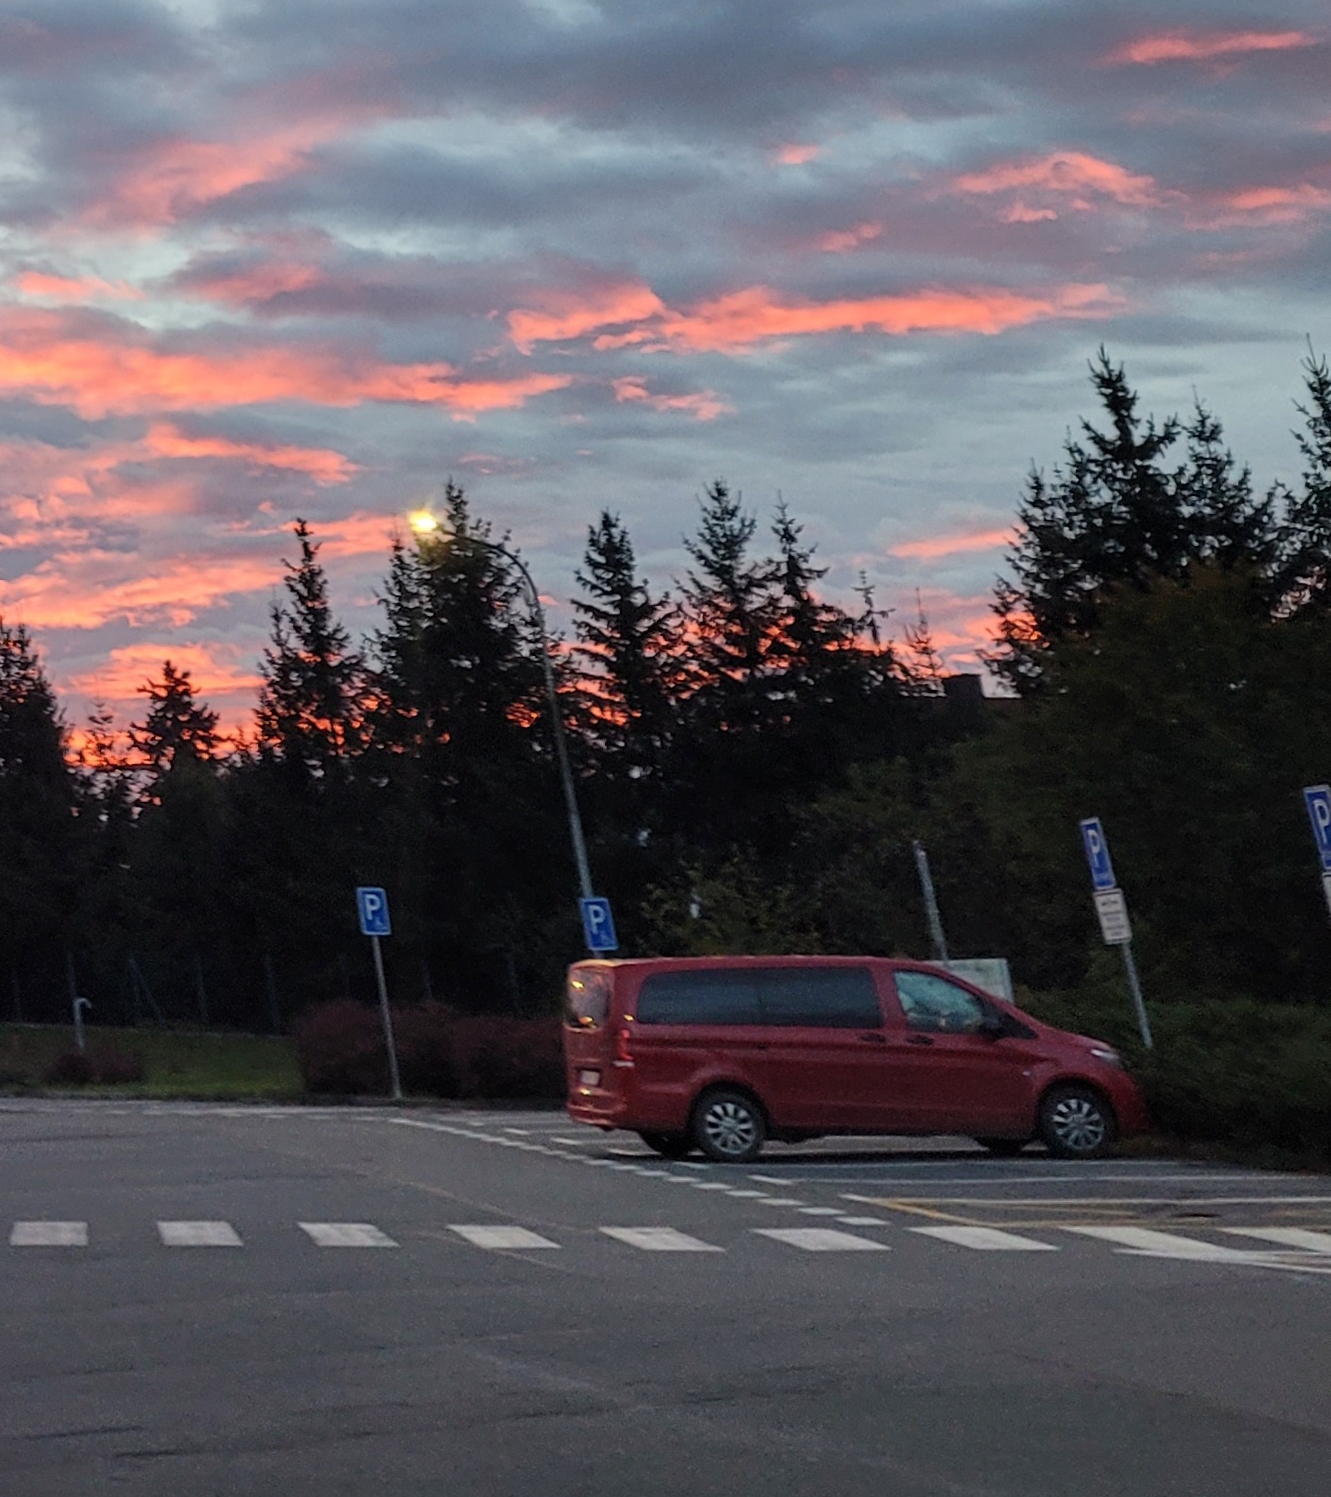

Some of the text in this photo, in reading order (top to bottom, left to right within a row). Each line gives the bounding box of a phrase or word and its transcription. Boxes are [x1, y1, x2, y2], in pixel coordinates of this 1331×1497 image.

[1313, 799, 1330, 844] P
[1087, 829, 1100, 867] P
[365, 894, 380, 920] P
[588, 904, 605, 934] P
